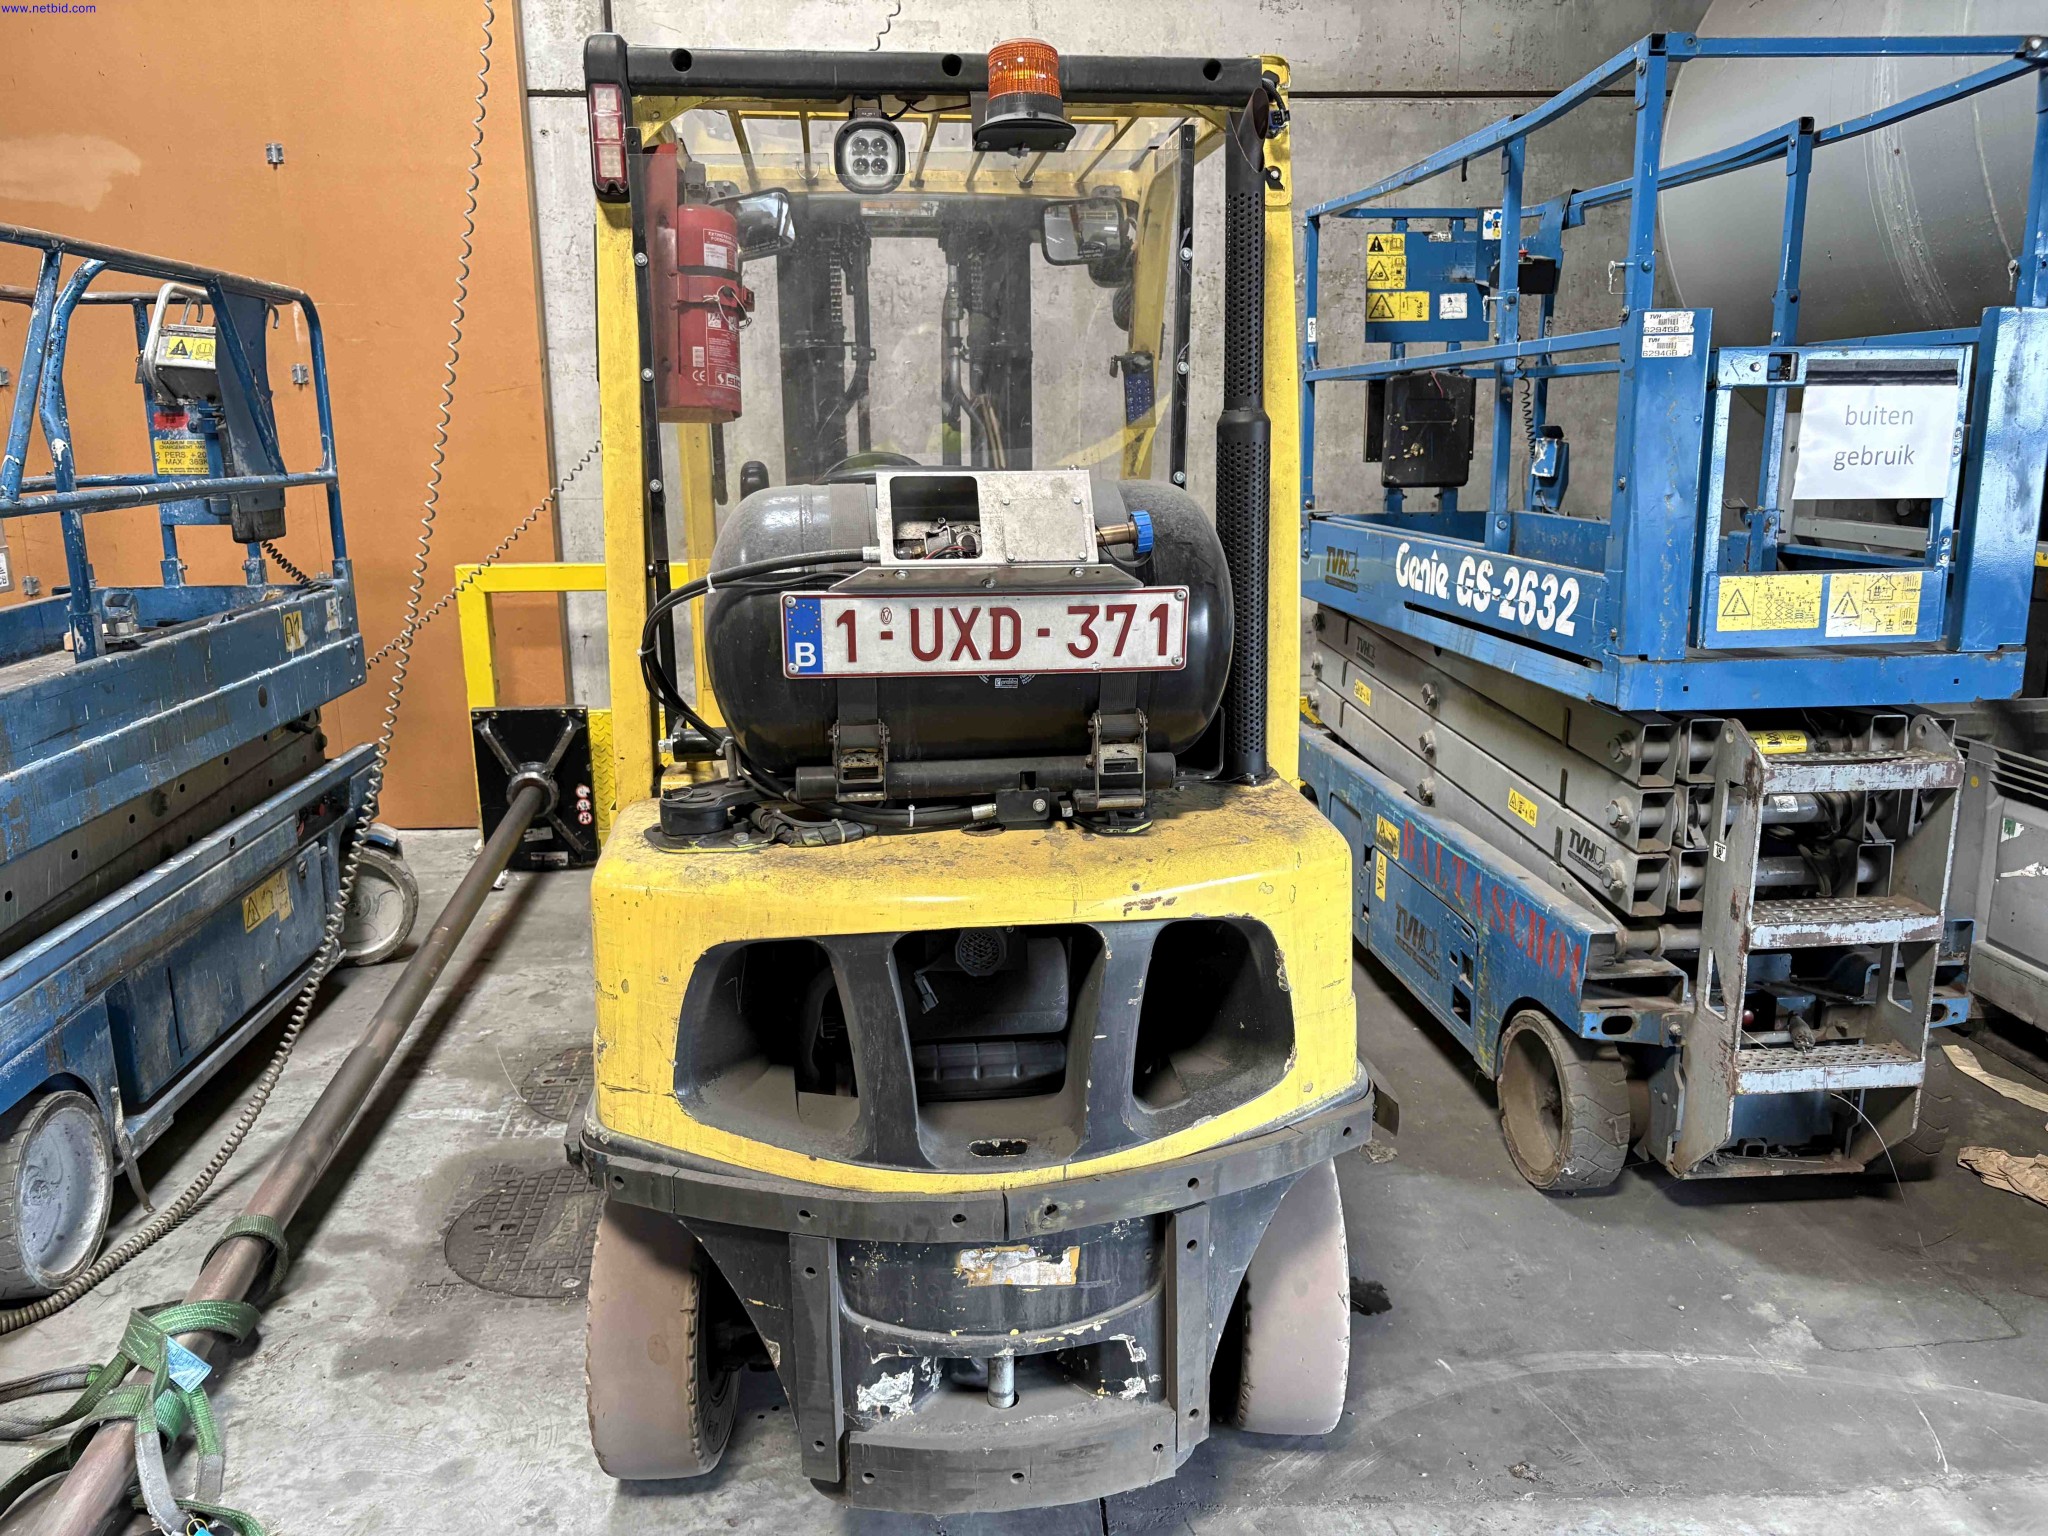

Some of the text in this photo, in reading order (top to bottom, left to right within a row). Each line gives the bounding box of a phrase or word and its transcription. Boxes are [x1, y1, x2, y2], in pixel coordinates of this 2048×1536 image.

[1845, 405, 1914, 426] buiten
[1833, 444, 1915, 471] gebruik
[1396, 541, 1580, 637] Genie GS-2632
[794, 641, 817, 668] B
[1569, 827, 1598, 864] TVH
